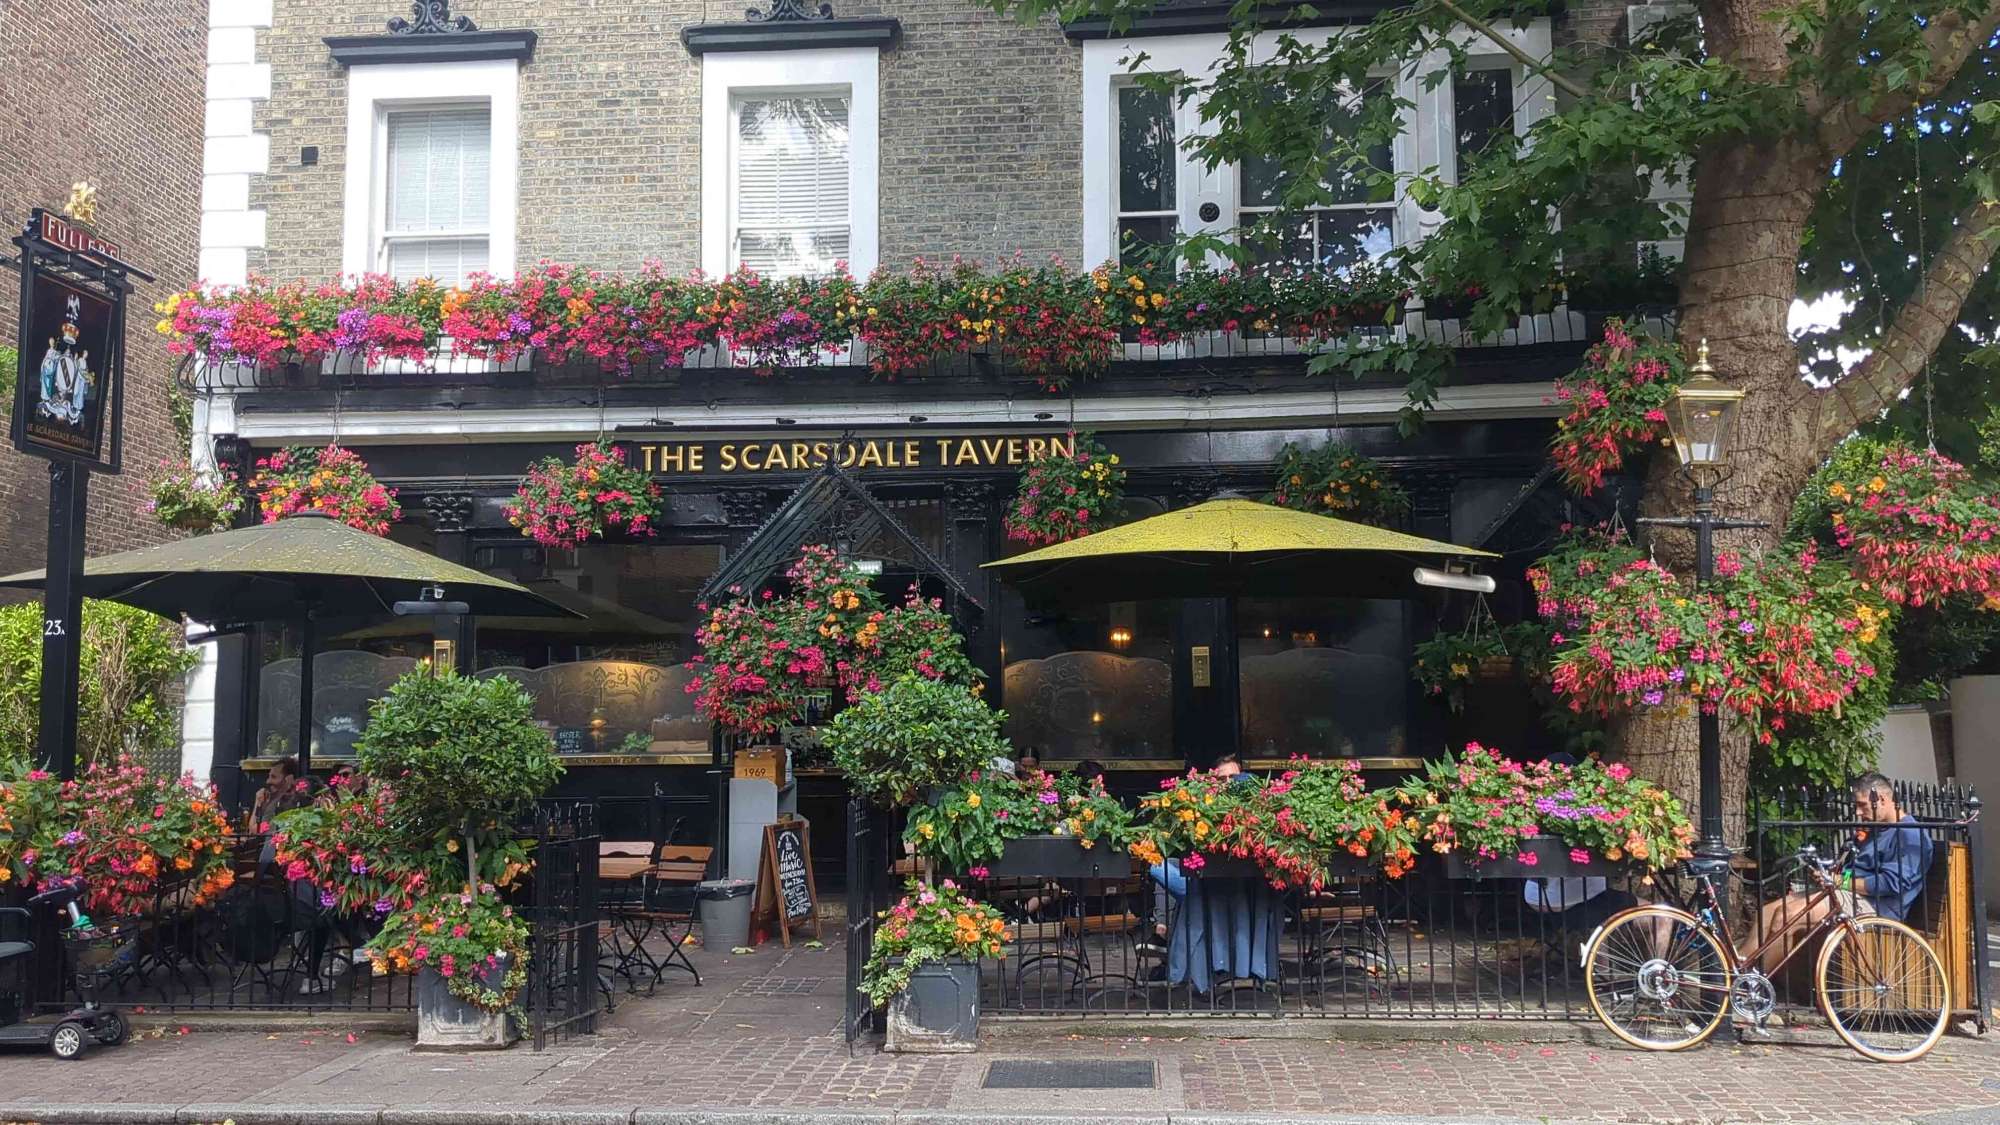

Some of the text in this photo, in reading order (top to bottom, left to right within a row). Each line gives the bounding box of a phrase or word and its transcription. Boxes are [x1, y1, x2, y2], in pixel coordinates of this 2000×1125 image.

[48, 216, 117, 259] FULLER'S
[640, 436, 1075, 472] THE SCARSDALE TAVERN
[743, 767, 767, 777] 1969
[780, 849, 798, 862] Live
